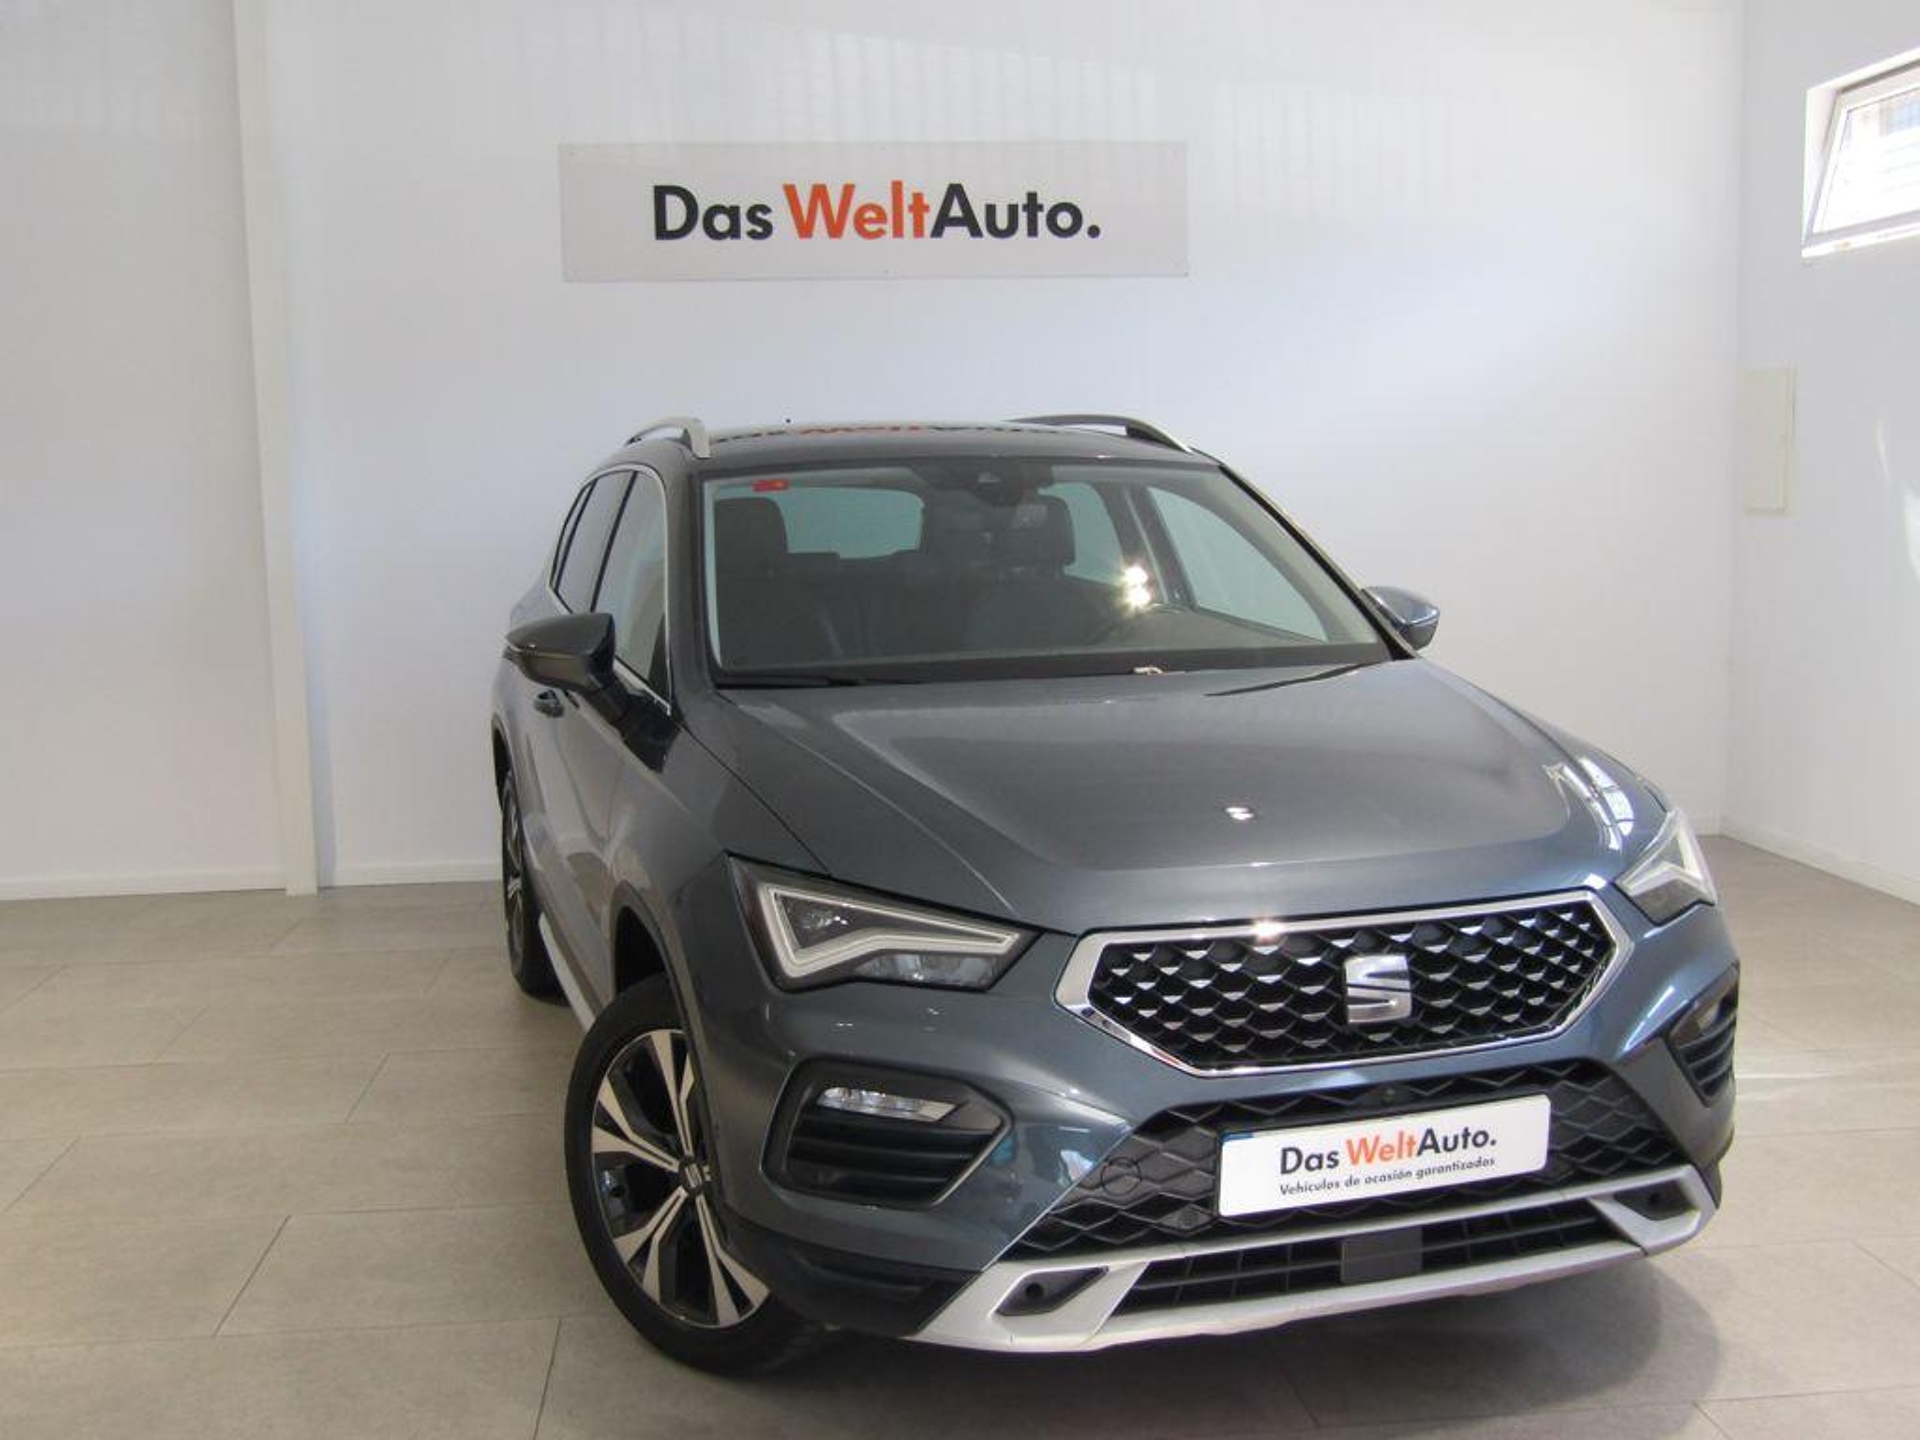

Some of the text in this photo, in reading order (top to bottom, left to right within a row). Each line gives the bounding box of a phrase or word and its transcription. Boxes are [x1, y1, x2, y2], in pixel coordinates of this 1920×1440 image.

[653, 179, 1101, 241] Das WeltAuto.
[1280, 1126, 1498, 1175] Das WeltAuto.
[1344, 1174, 1360, 1188] de
[1415, 1156, 1495, 1180] garantizados
